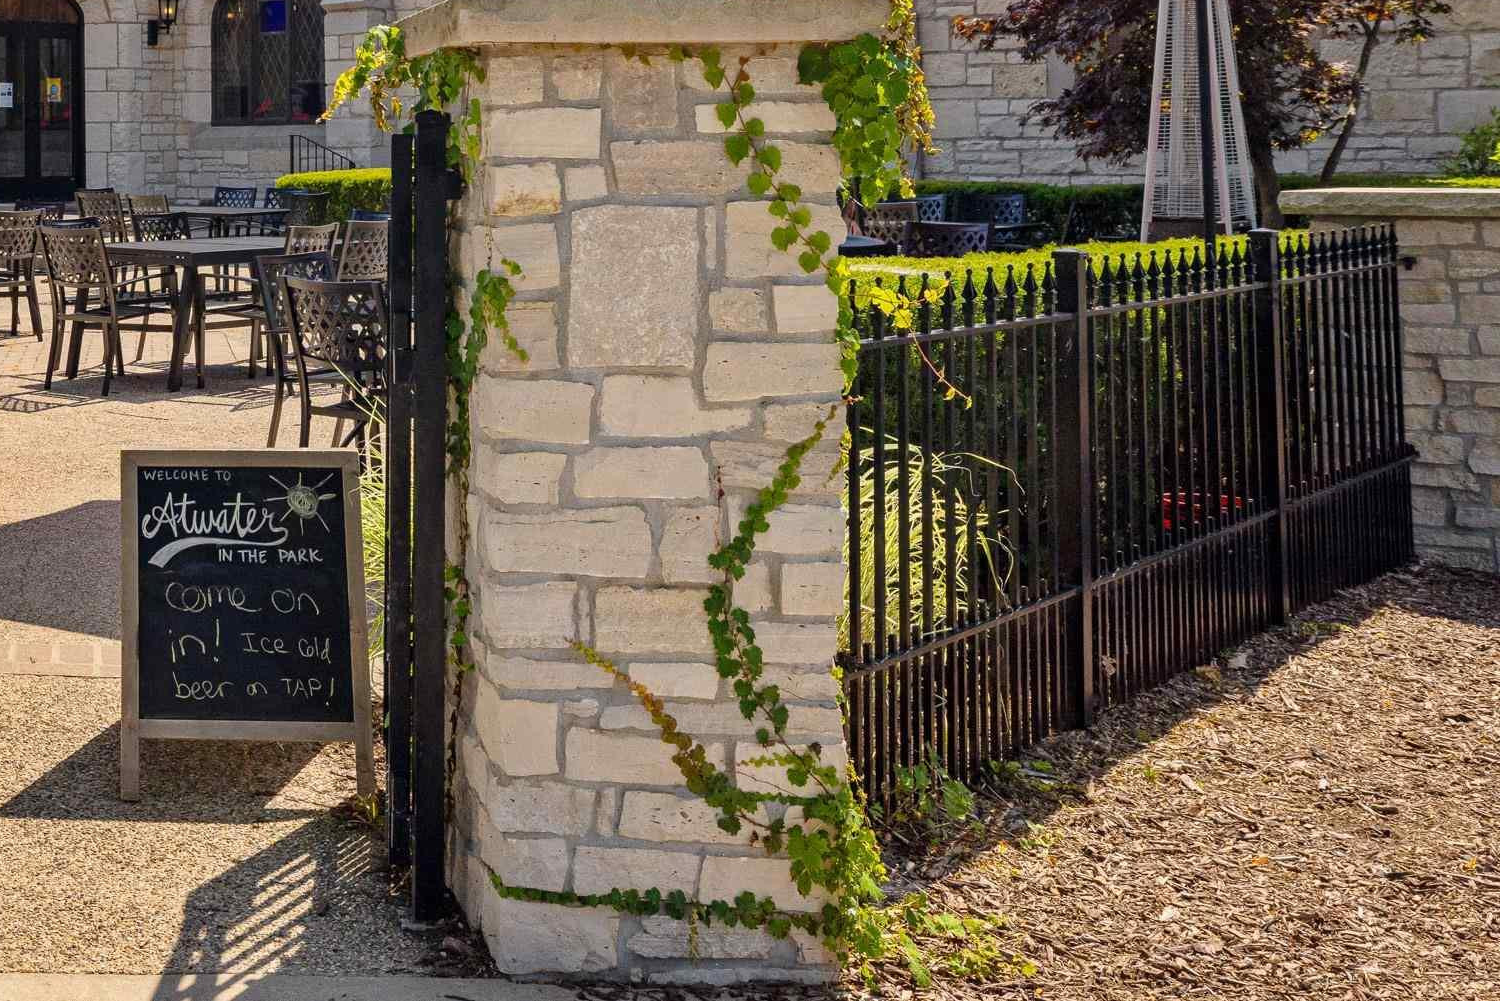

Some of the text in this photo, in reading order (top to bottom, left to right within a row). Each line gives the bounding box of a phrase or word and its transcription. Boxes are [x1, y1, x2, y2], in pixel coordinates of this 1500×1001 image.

[144, 470, 232, 482] WELCOME TO
[218, 548, 323, 564] IN THE PARK
[170, 618, 221, 664] in!
[240, 632, 291, 654] Ice
[172, 671, 336, 707] beer on TAP!
